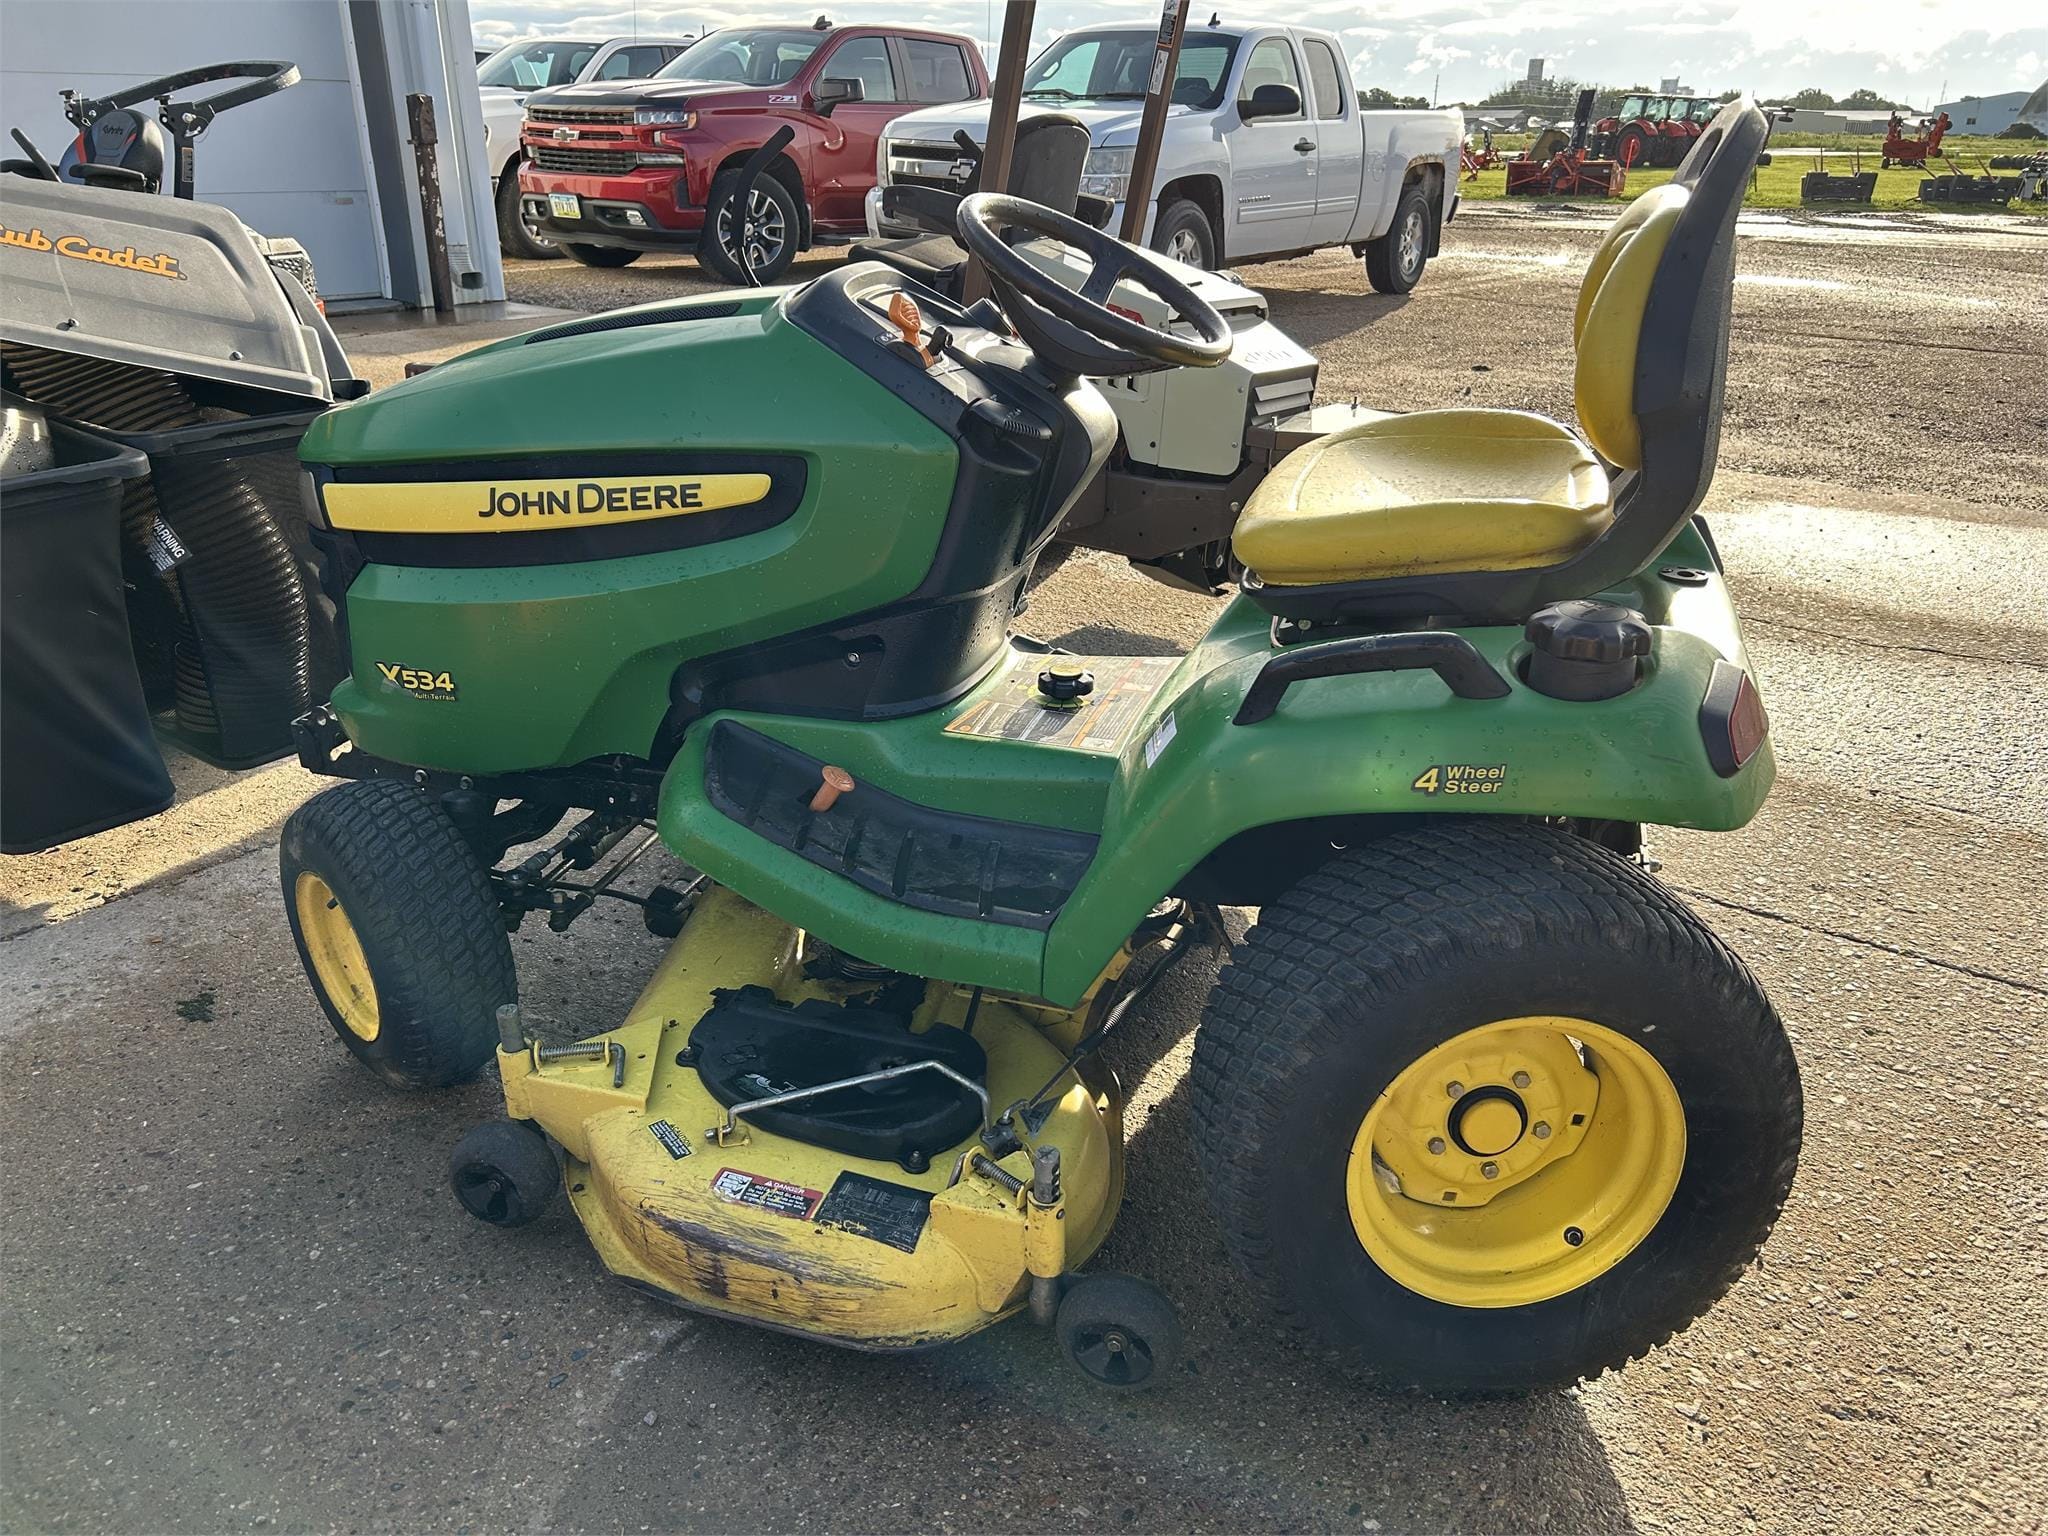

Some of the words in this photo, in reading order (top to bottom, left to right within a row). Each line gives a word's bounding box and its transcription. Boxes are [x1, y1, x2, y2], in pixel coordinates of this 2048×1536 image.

[0, 223, 52, 252] ub
[56, 236, 179, 279] Cadet
[478, 487, 571, 518] JOHN
[577, 483, 703, 514] DEERE
[1414, 767, 1439, 793] 4
[1446, 765, 1506, 780] Wheel
[1443, 780, 1503, 794] Steer
[774, 1182, 805, 1194] DANGER
